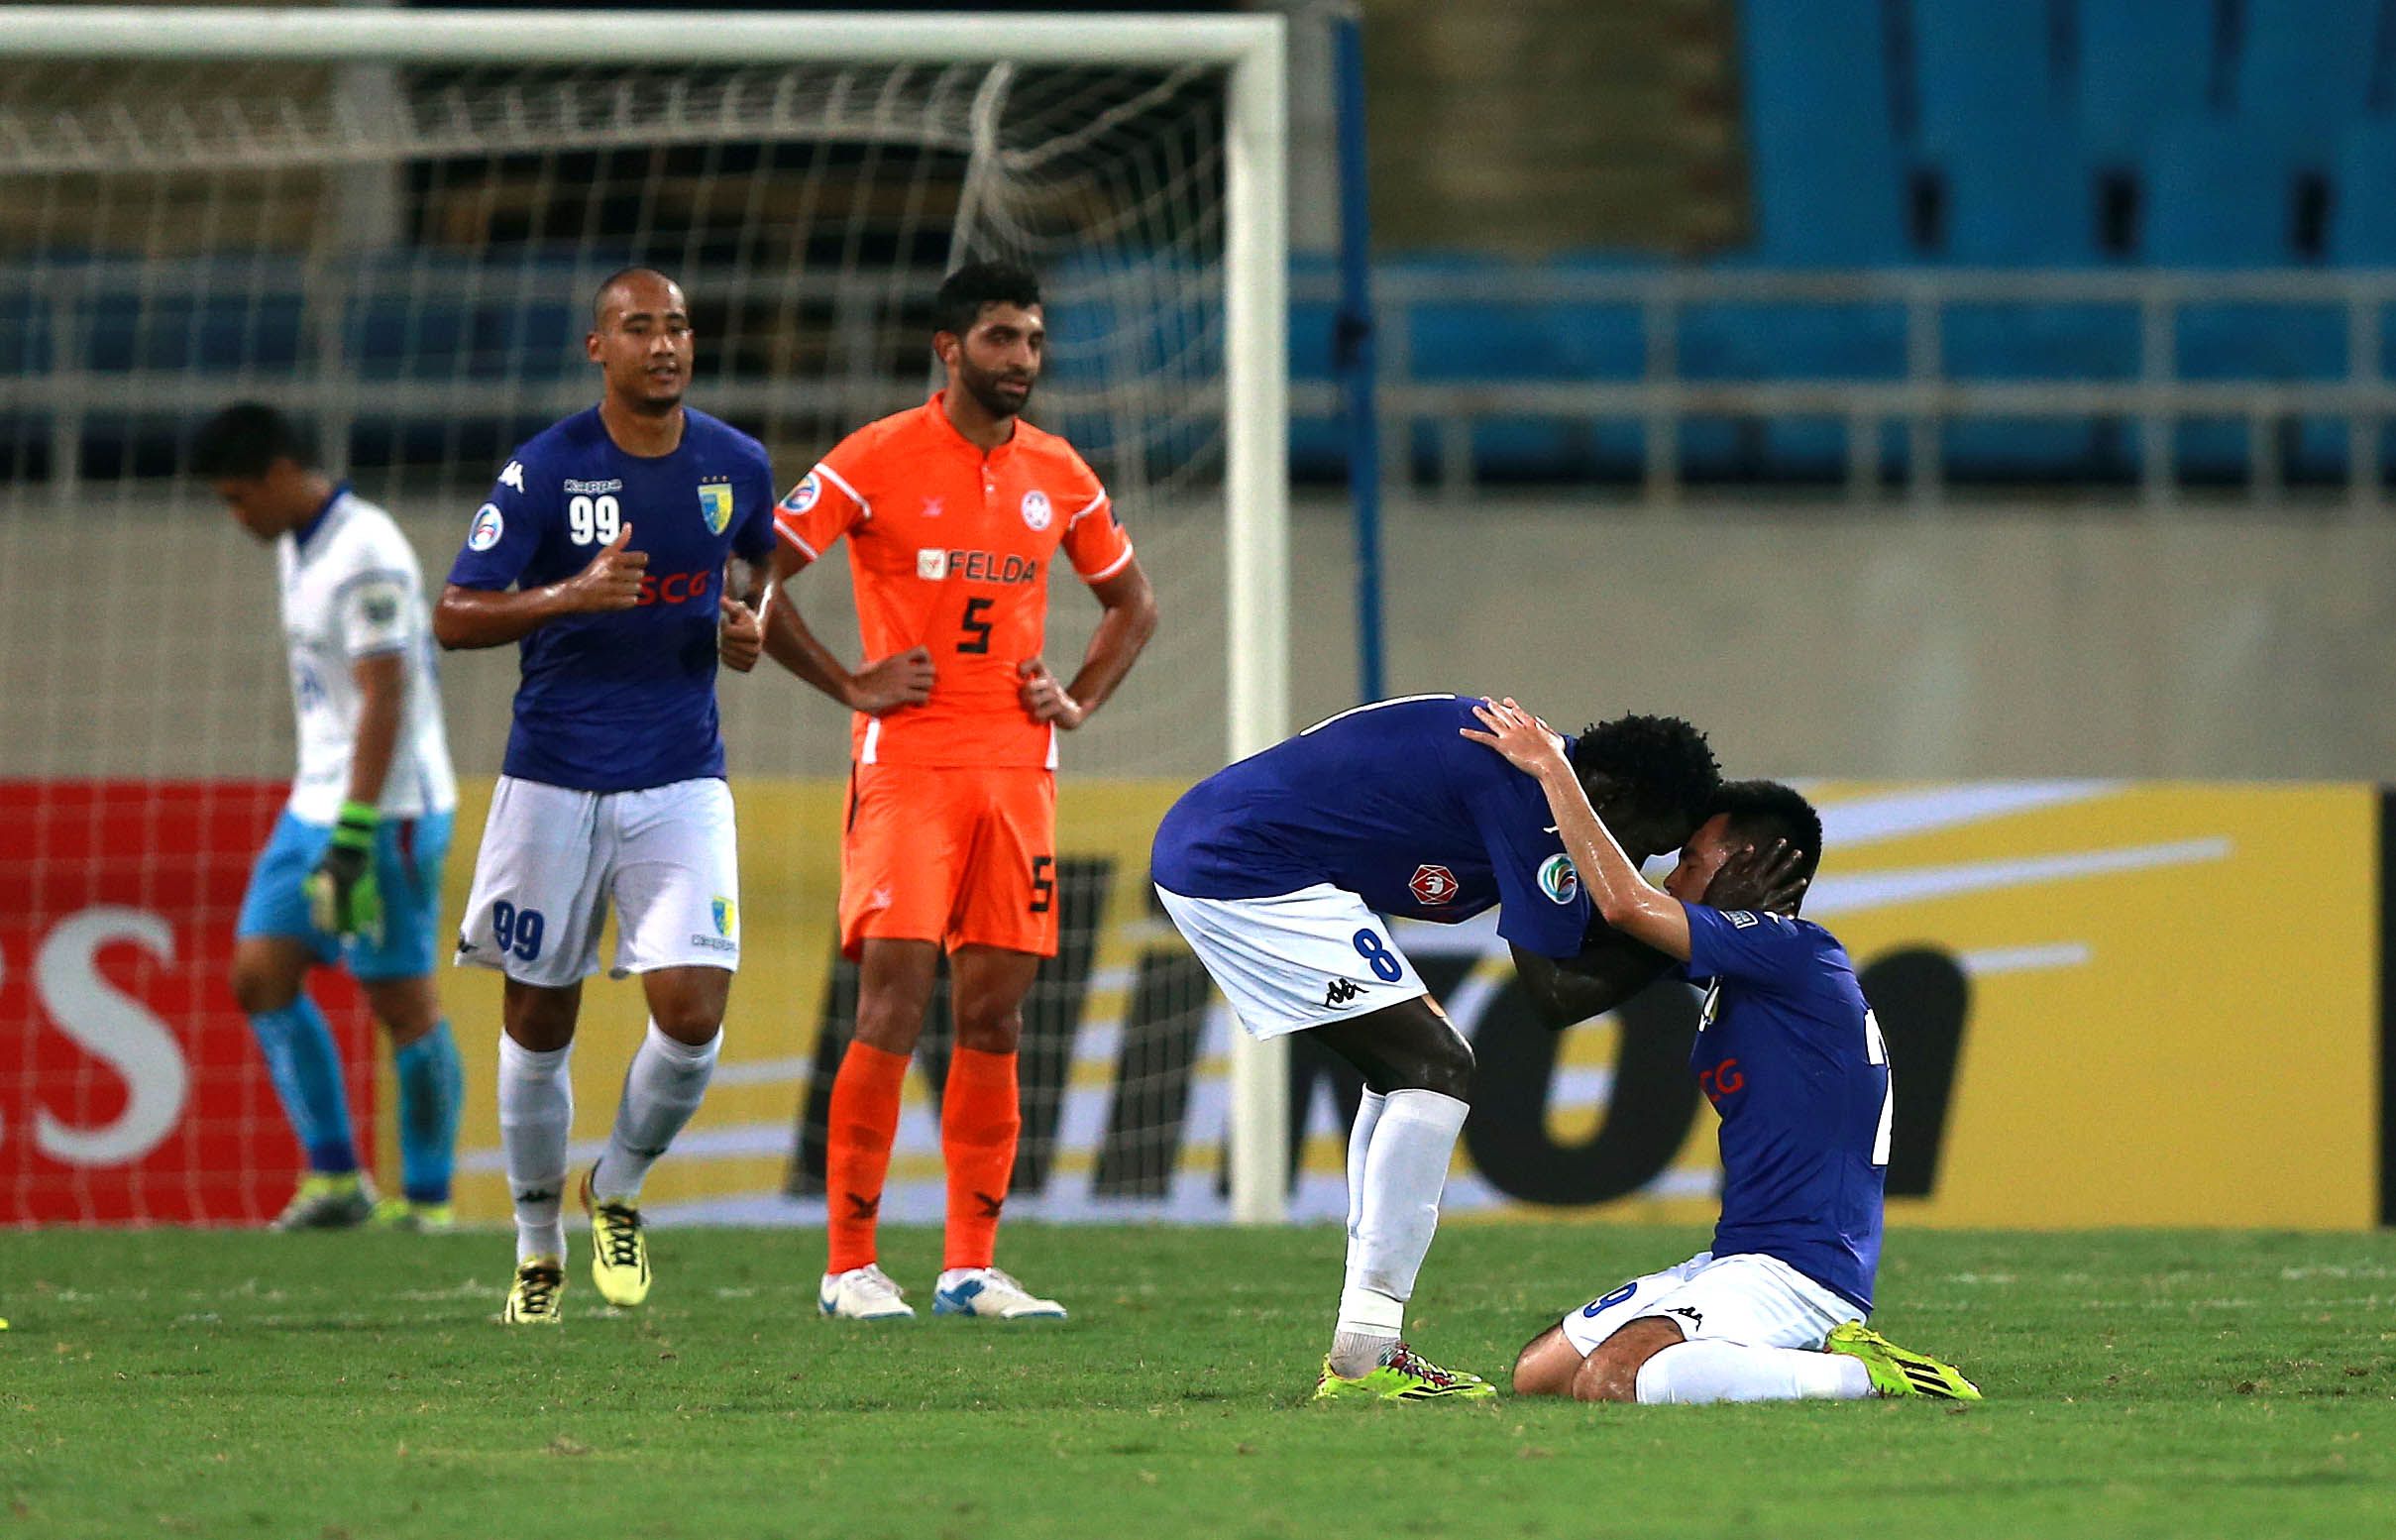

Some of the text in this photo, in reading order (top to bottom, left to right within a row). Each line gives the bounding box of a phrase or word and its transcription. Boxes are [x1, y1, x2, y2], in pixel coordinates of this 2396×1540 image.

[570, 495, 620, 546] 99
[948, 550, 1036, 584] FELDA
[956, 598, 995, 654] 5
[1030, 856, 1052, 912] 5
[493, 901, 544, 961] 99
[1353, 929, 1402, 982] 8
[1583, 1282, 1638, 1318] 9
